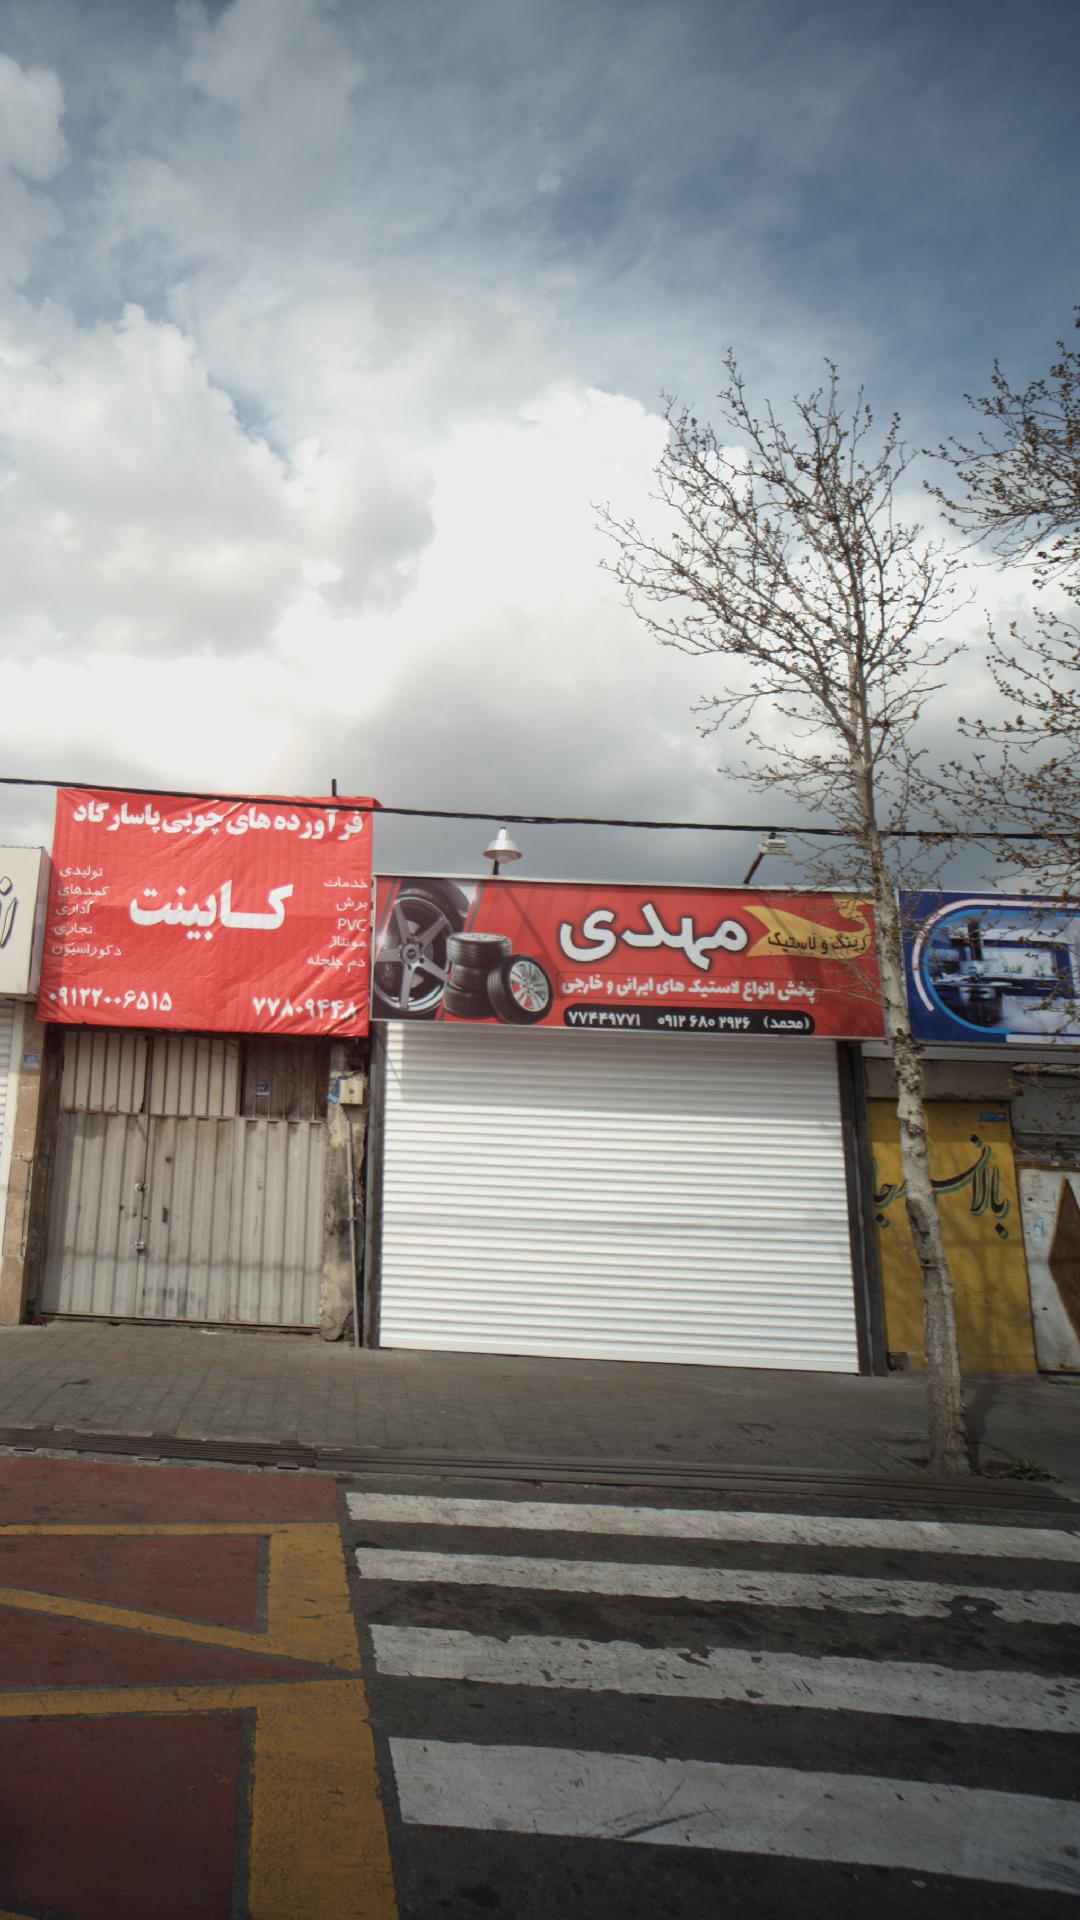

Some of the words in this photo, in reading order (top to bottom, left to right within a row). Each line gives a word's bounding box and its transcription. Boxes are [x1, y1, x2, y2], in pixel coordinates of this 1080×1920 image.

[73, 800, 160, 833] پاسارگاد
[162, 811, 225, 836] چوبی
[59, 865, 104, 880] تولیدی
[57, 884, 110, 896] کمدهای
[323, 877, 368, 889] خدمات
[129, 880, 294, 941] کابینت
[336, 897, 368, 912] برش
[337, 918, 367, 932] PVC
[328, 934, 367, 951] مونتاژ
[559, 903, 748, 971] مهدی
[767, 932, 817, 953] لاستیک
[821, 940, 829, 955] و
[347, 958, 366, 973] دم
[561, 974, 604, 994] خارجی
[606, 981, 614, 996] و
[616, 976, 654, 997] ایرانی
[656, 978, 685, 995] های
[688, 979, 740, 998] لاستیک
[742, 981, 775, 1002] انواع
[777, 981, 816, 1004] پخش
